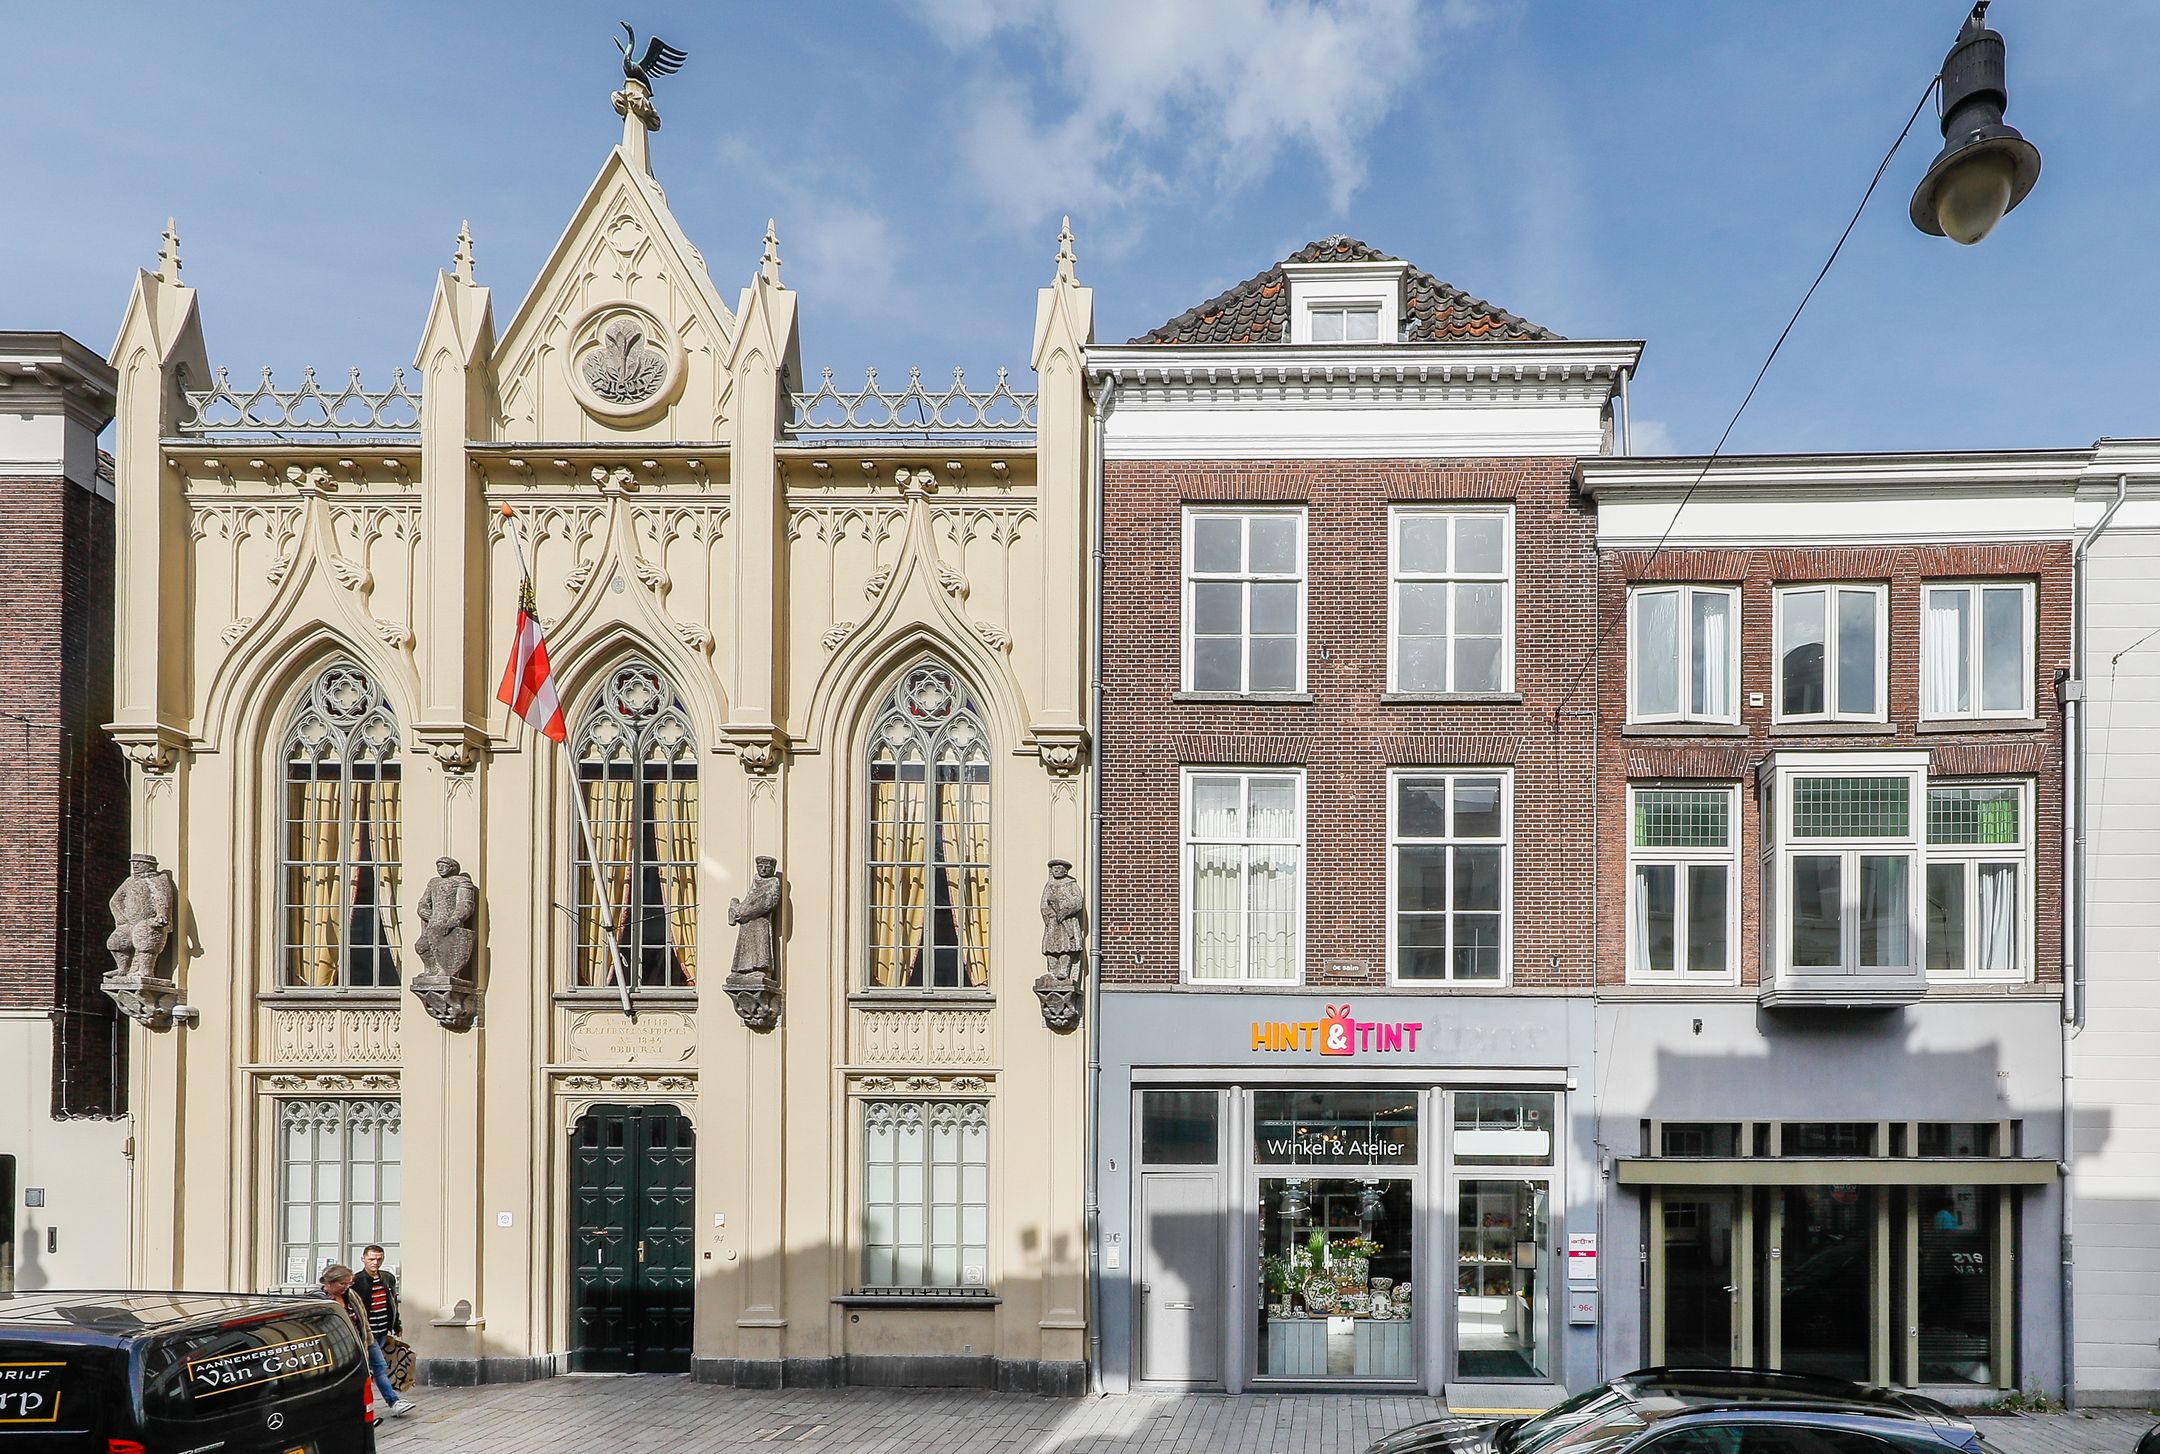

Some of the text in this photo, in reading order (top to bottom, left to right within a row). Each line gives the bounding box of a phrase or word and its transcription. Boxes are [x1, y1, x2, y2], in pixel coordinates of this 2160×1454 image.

[1252, 1021, 1318, 1052] HINT
[1327, 1024, 1347, 1050] &
[1356, 1022, 1422, 1052] TINT
[1267, 1139, 1405, 1156] Winkel & Atelier
[1578, 1304, 1593, 1312] 96c
[195, 1338, 321, 1372] AANNEMERSBEDRIJF
[0, 1370, 50, 1380] RIJF
[197, 1350, 324, 1387] Van Gorp
